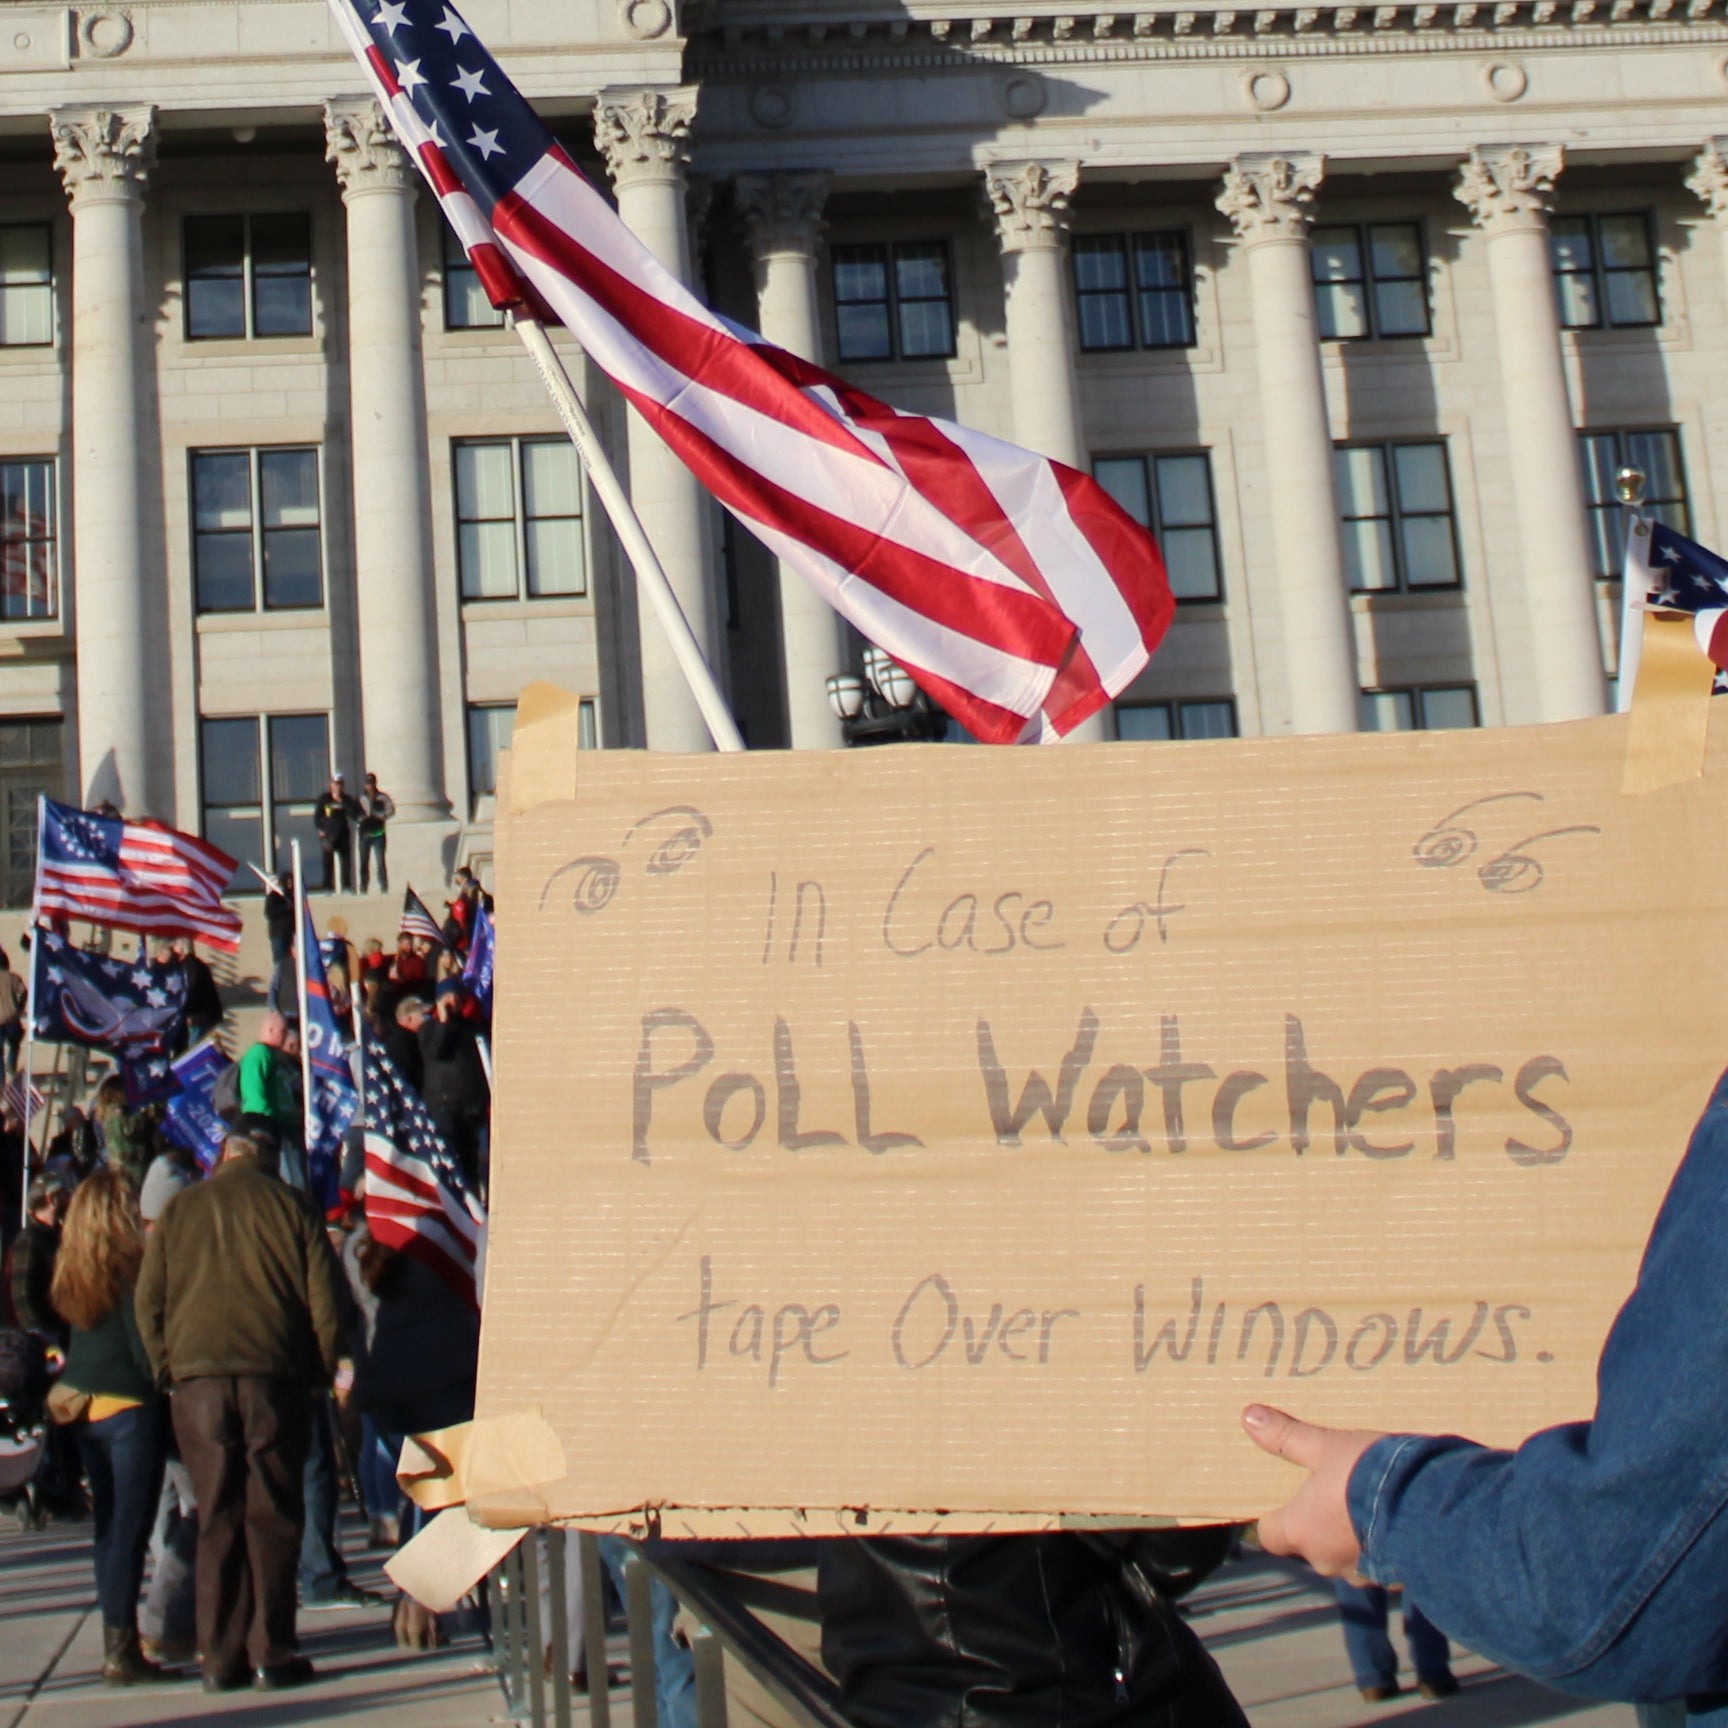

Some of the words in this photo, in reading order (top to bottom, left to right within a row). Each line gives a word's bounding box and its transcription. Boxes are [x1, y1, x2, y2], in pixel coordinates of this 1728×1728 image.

[883, 846, 1065, 959] Case
[1102, 847, 1211, 956] of
[976, 1006, 1573, 1167] Watchers
[677, 1255, 849, 1389] tape
[891, 1273, 1079, 1370] Over
